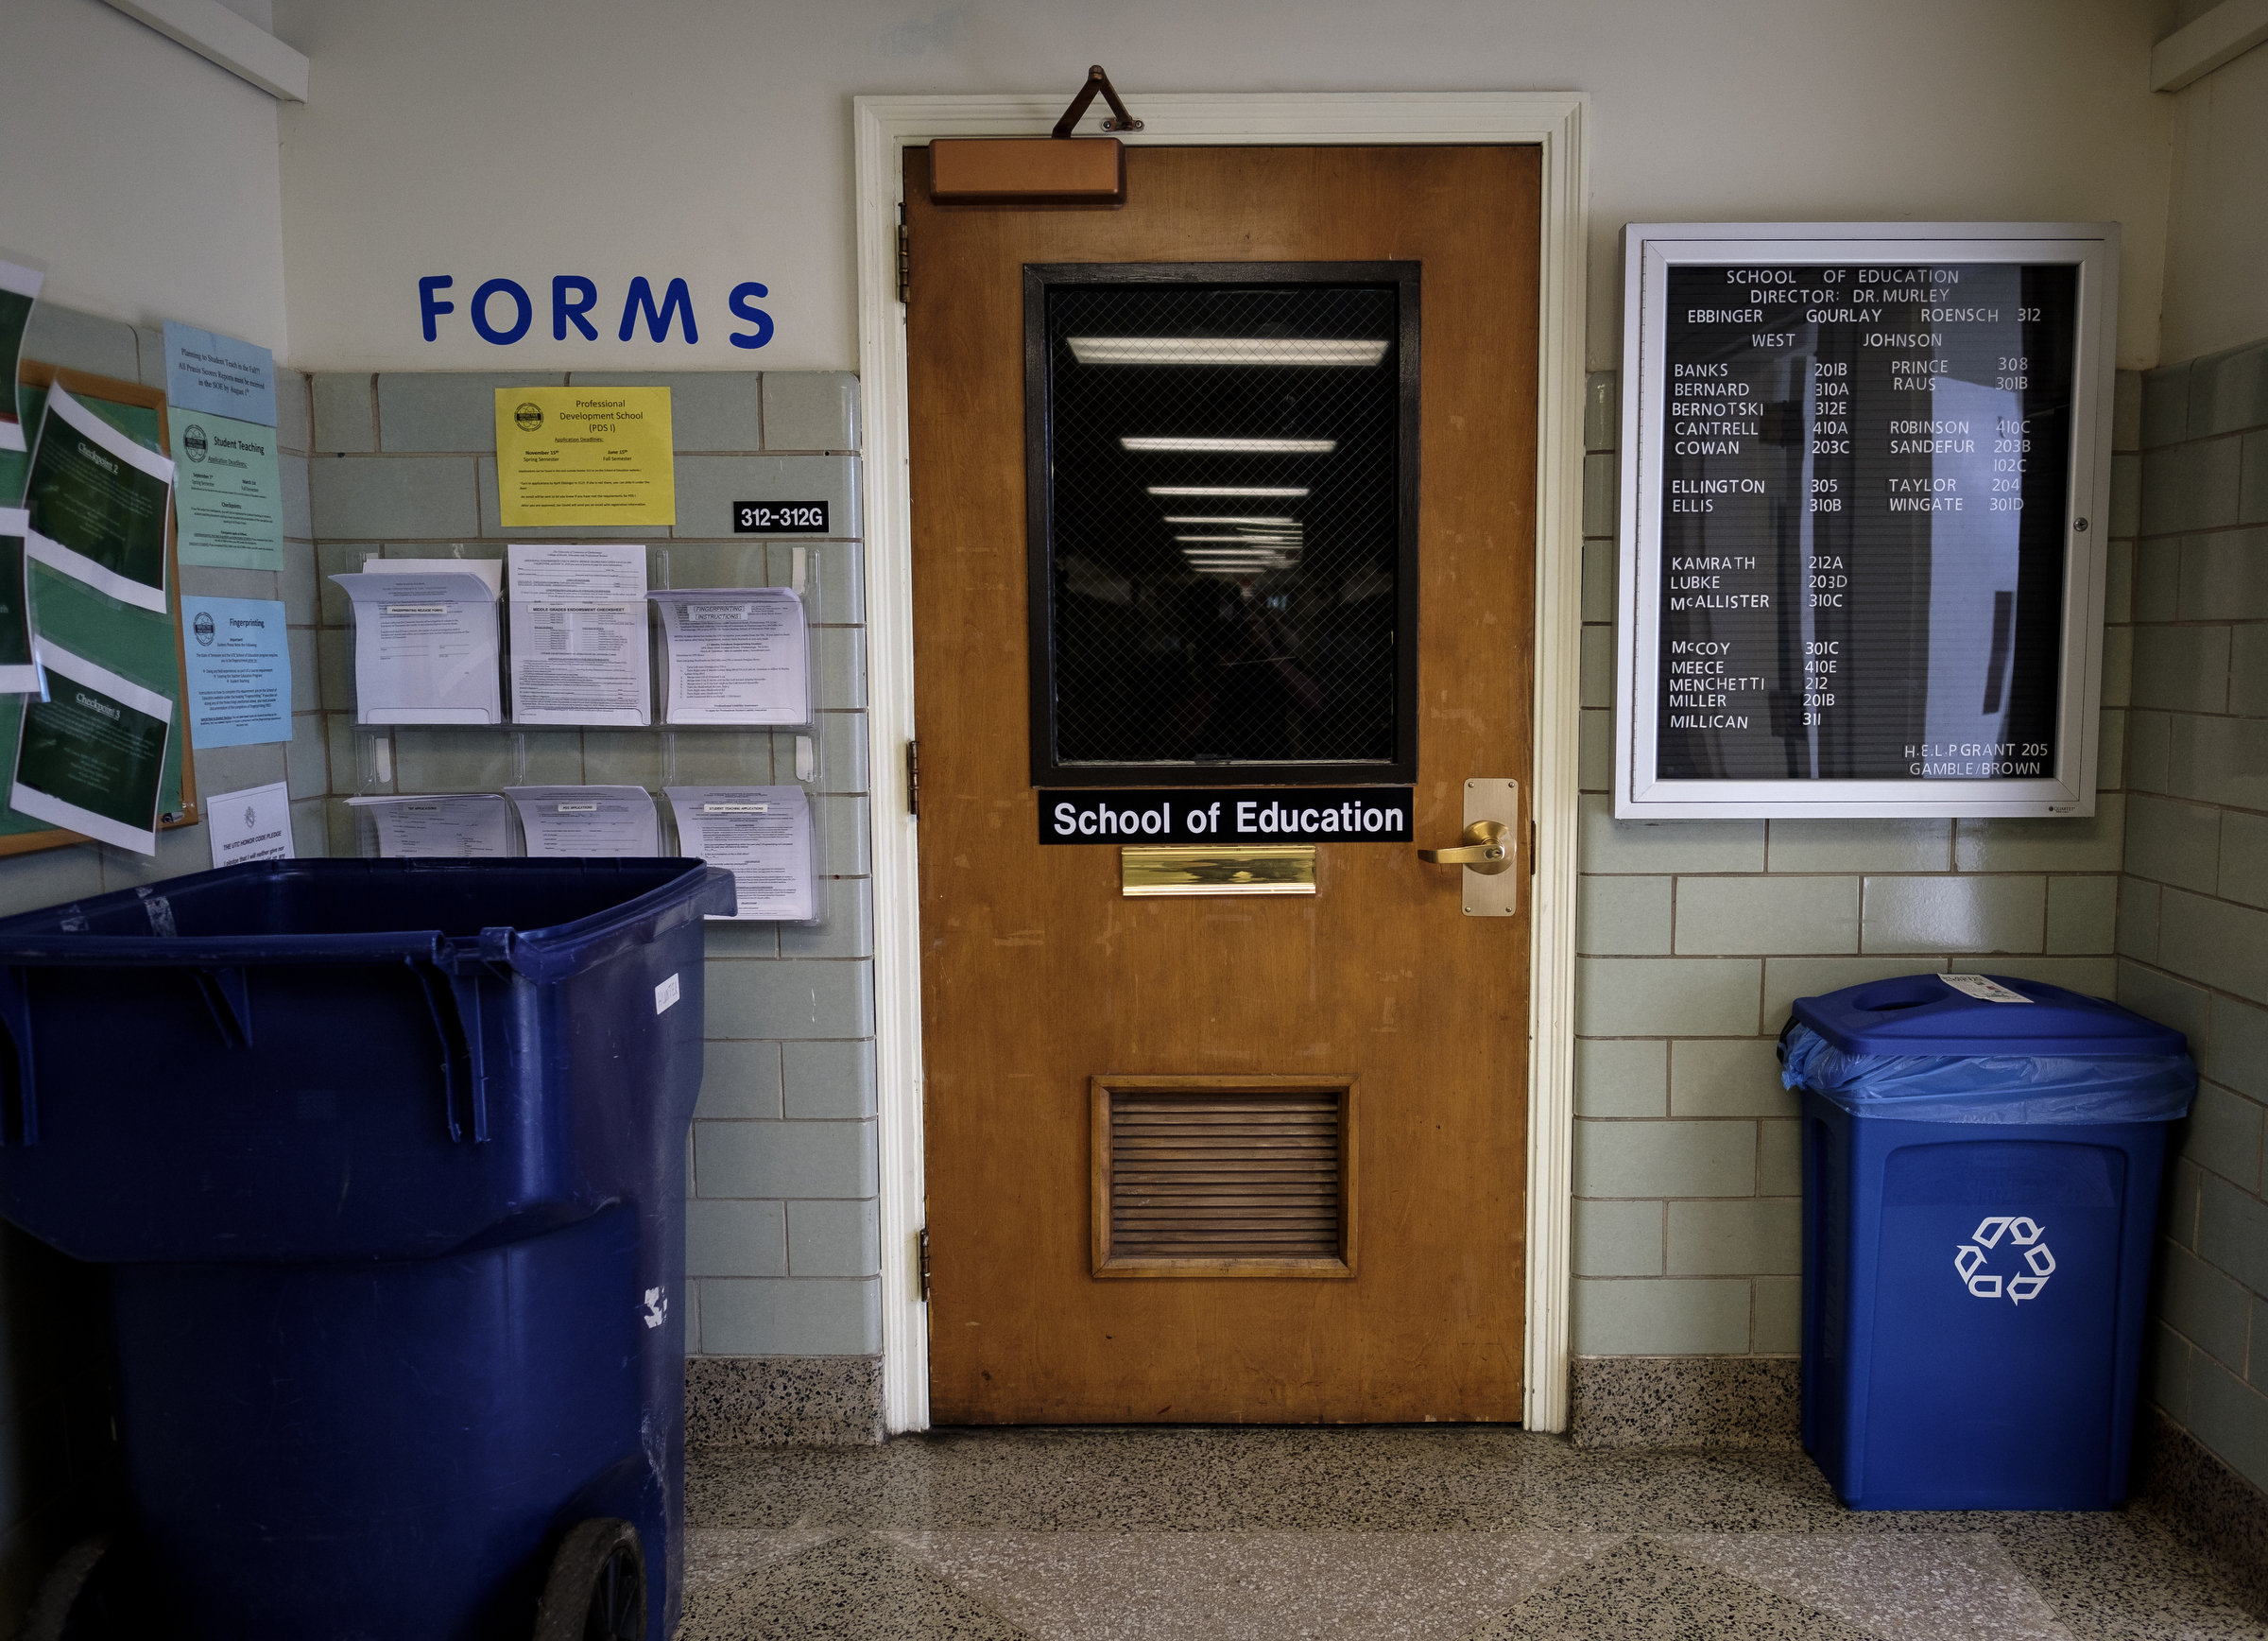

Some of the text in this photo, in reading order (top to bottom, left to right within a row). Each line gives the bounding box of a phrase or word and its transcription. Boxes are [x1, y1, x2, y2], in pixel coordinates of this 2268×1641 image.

[1727, 269, 1958, 284] SCHOOL OF EDUCATION
[1751, 289, 1839, 303] DIRECTOR:
[419, 275, 775, 350] FORMS
[1689, 308, 2040, 323] EBBINGER GOURLAY ROENSCH 312
[1752, 334, 1941, 347] WEST JOHNSON
[208, 354, 225, 365] Student
[1892, 357, 2028, 373] PRINCE 308
[1675, 363, 1847, 377] BANKS 201B
[1675, 383, 1848, 396] BERNARD 310A
[1894, 376, 2028, 390] RAUS 301B
[1673, 402, 1847, 416] BERNOTSKI 312E
[559, 412, 614, 421] Development
[589, 423, 616, 433] (PDS I)
[1675, 421, 1847, 435] CANTRELL 410A
[1891, 421, 2030, 435] ROBINSON 410C
[214, 437, 237, 449] Student
[238, 440, 265, 456] Teaching
[1675, 440, 1849, 455] COWAN 203C
[1891, 440, 2031, 454] SANDEFUR 203B
[77, 442, 113, 472] Checkpoint
[1995, 458, 2026, 472] 102C
[1673, 479, 1837, 493] ELLINGTON 305
[1889, 478, 2019, 492] TAYLOR 204
[1673, 499, 1841, 512] ELLIS 310B
[1890, 498, 2024, 511] WINGATE 301D
[741, 508, 823, 527] 312-312G
[1673, 556, 1843, 570] KAMRATH 212A
[1671, 575, 1847, 589] LUBKE 203D
[1810, 594, 1843, 607] 310C
[230, 618, 265, 629] Fingerprinting
[1806, 642, 1838, 655] 301C
[1672, 661, 1836, 674] MEECE 410E
[1670, 677, 1828, 691] MENCHETTI 212
[1670, 690, 1834, 707] MILLER 201B
[76, 693, 115, 719] Checkpoint
[1671, 715, 1747, 729] MILLICAN
[1961, 743, 2016, 756] GRANT
[2021, 743, 2048, 756] 205
[1910, 762, 2040, 775] GAMBLE/BROWN
[1054, 801, 1404, 836] School of Education
[232, 840, 240, 849] UTC
[240, 838, 255, 846] HONOR
[266, 830, 282, 839] PLEDGE
